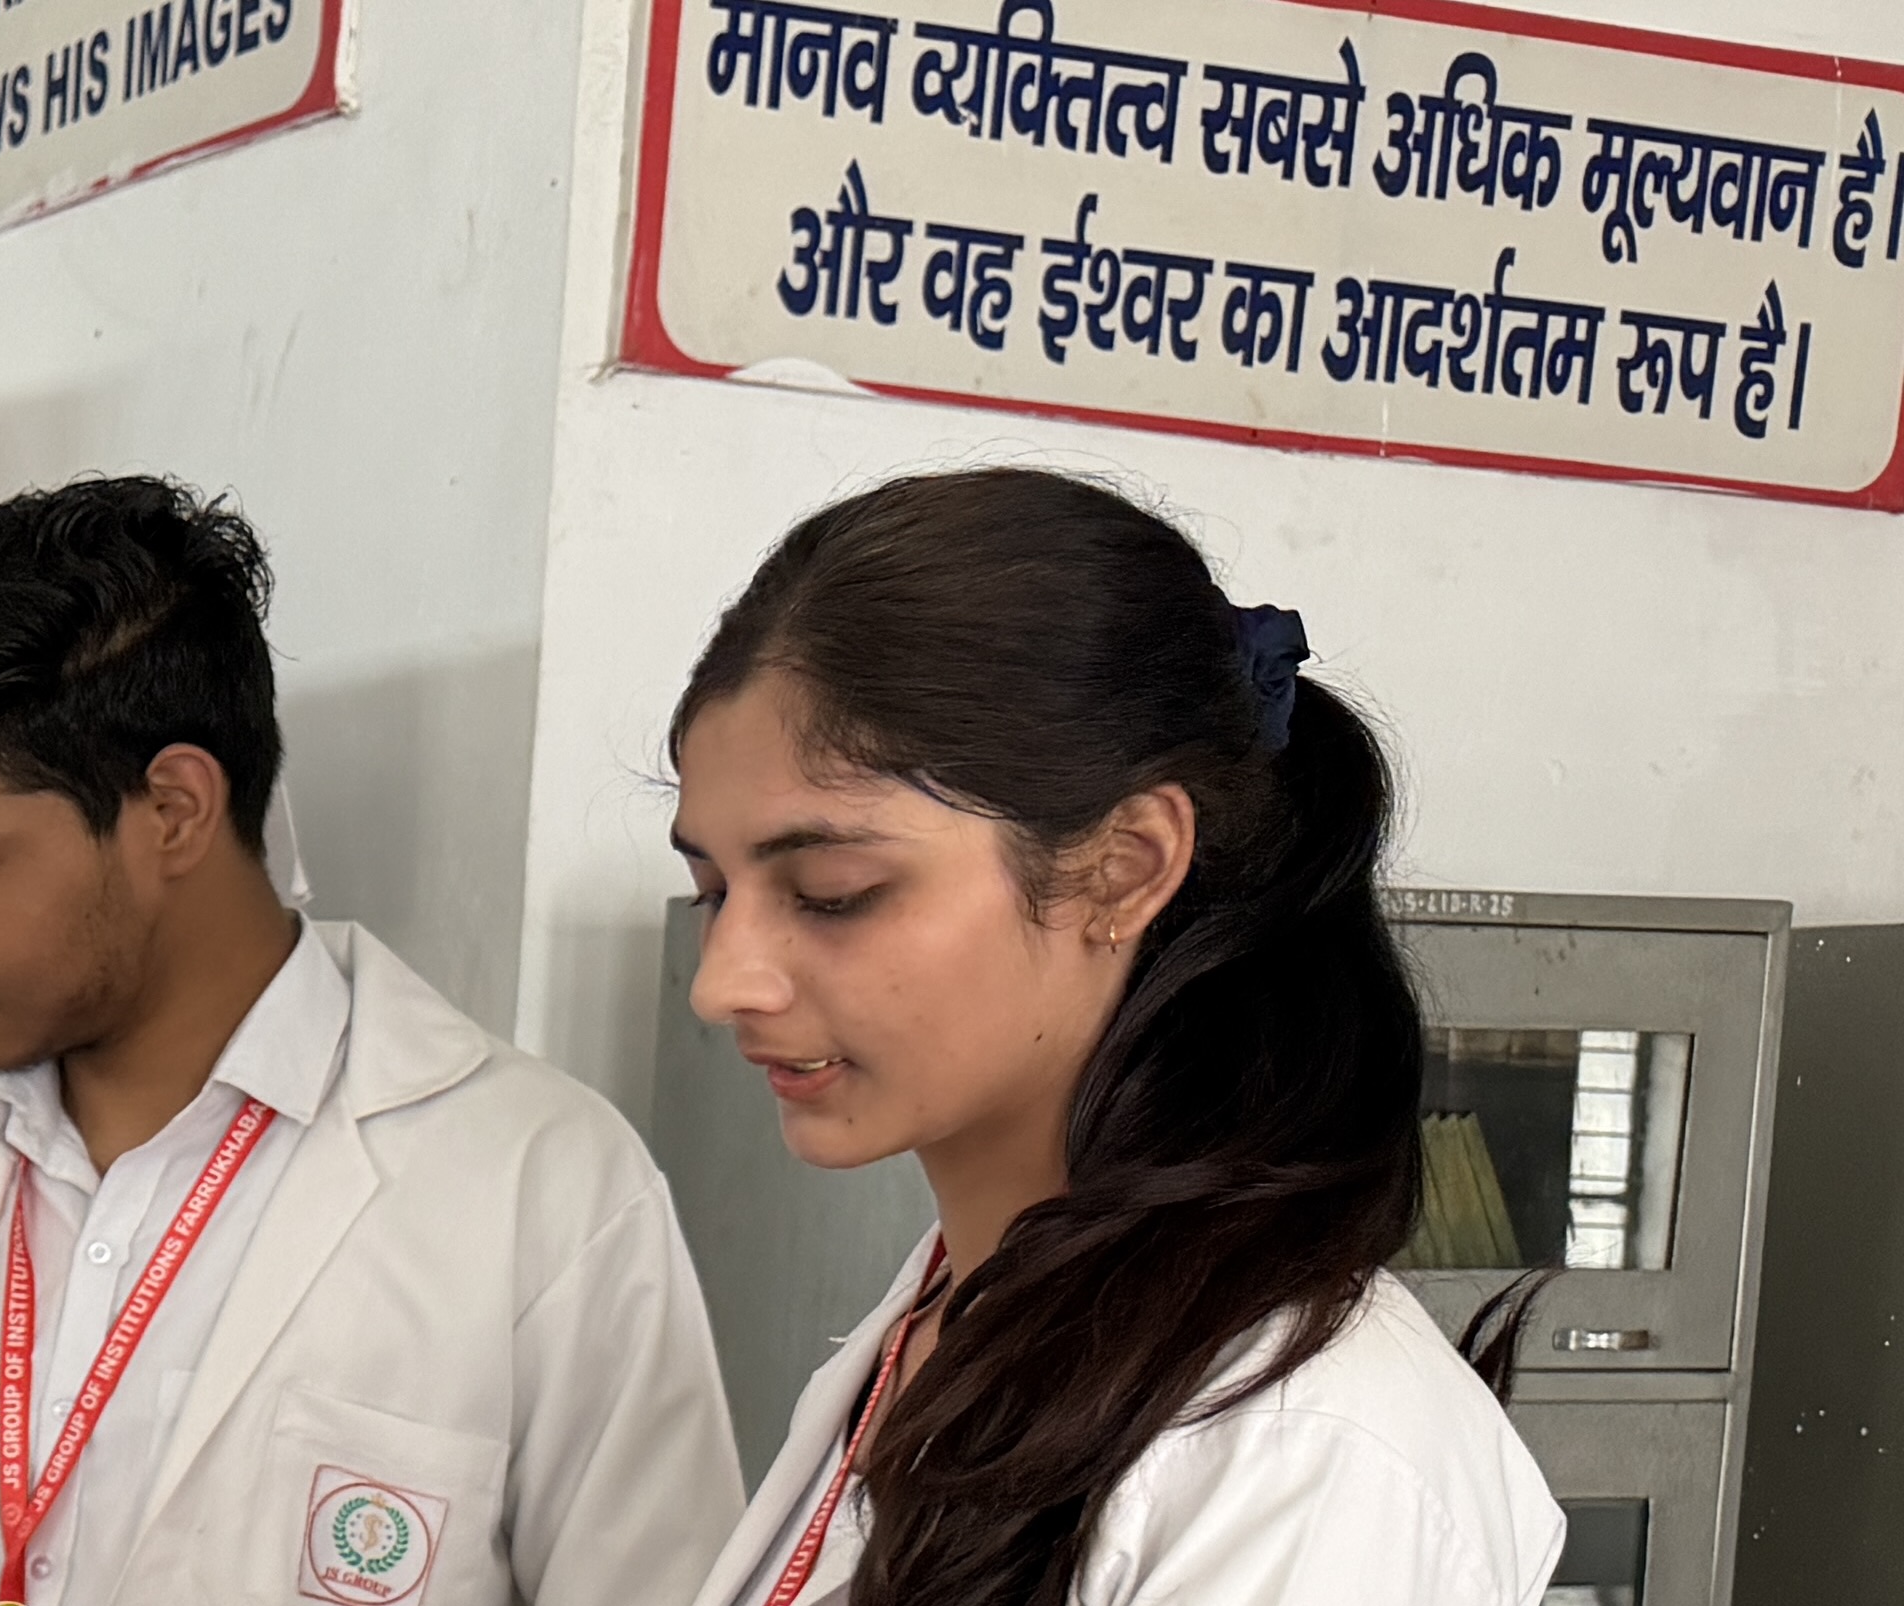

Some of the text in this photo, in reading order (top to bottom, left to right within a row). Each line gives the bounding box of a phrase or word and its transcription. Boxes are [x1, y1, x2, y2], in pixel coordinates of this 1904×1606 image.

[42, 30, 109, 134] HIS
[123, 0, 293, 103] IMAGES
[707, 0, 897, 123] मानव
[912, 0, 1187, 164] व्यक्तित्व
[1202, 39, 1366, 190] सबसे
[1373, 53, 1571, 212] अधिक
[1581, 118, 1825, 264] मूल्यवान
[776, 159, 1812, 438] और वह ईश्वर का आदर्शतम रूप है।
[33, 1101, 272, 1513] JS GROUP OF INSTITUTIONS FARRUKHABA
[3, 1349, 26, 1380] OF
[2, 1383, 25, 1459] GROUP
[1, 1462, 21, 1489] JS
[341, 1570, 392, 1598] GROUP
